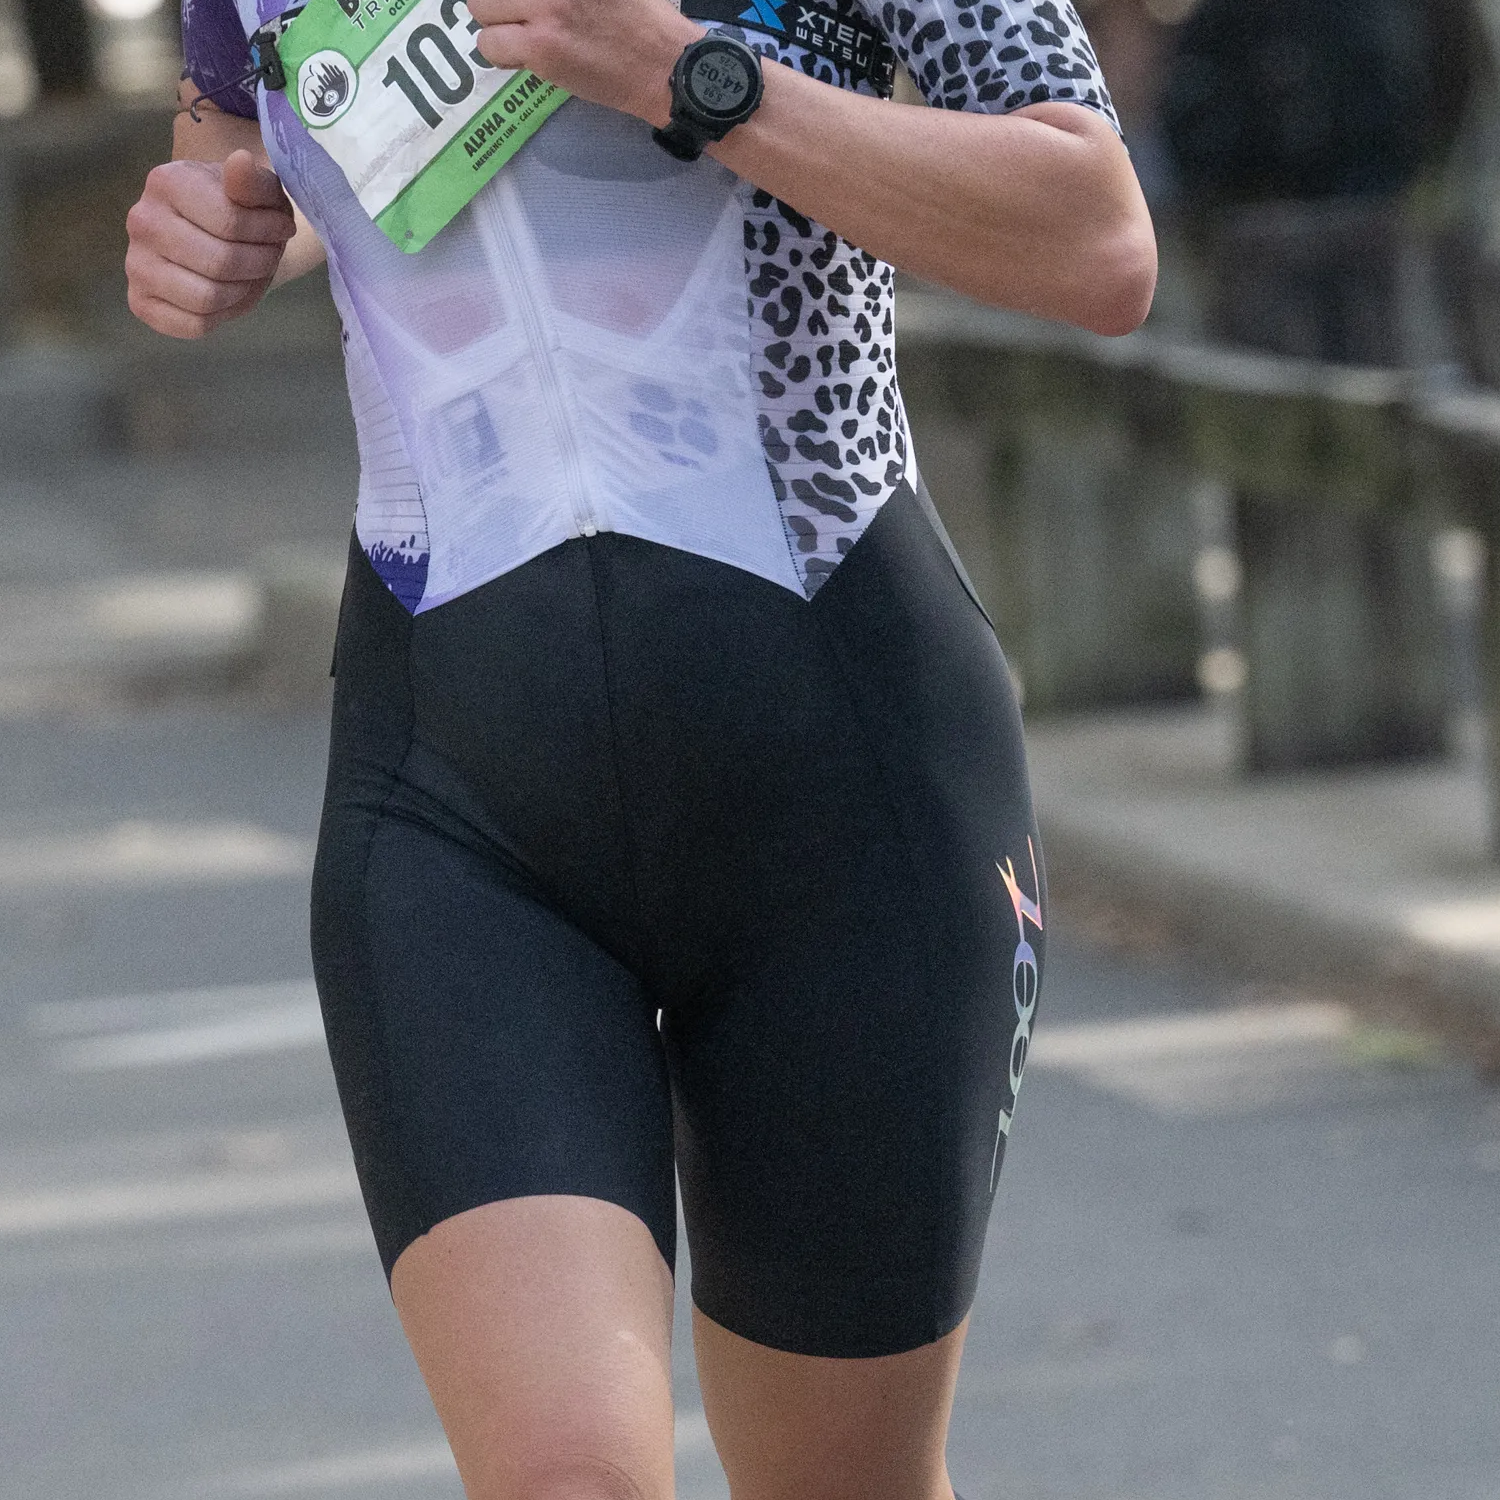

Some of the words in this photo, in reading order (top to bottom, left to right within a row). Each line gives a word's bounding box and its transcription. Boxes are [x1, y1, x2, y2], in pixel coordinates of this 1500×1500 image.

[697, 62, 744, 94] 44:05
[463, 112, 506, 158] ALPHA
[503, 73, 546, 114] OLYM
[472, 134, 505, 172] EMERGENCY
[503, 123, 518, 139] LINE
[519, 107, 535, 122] CALL
